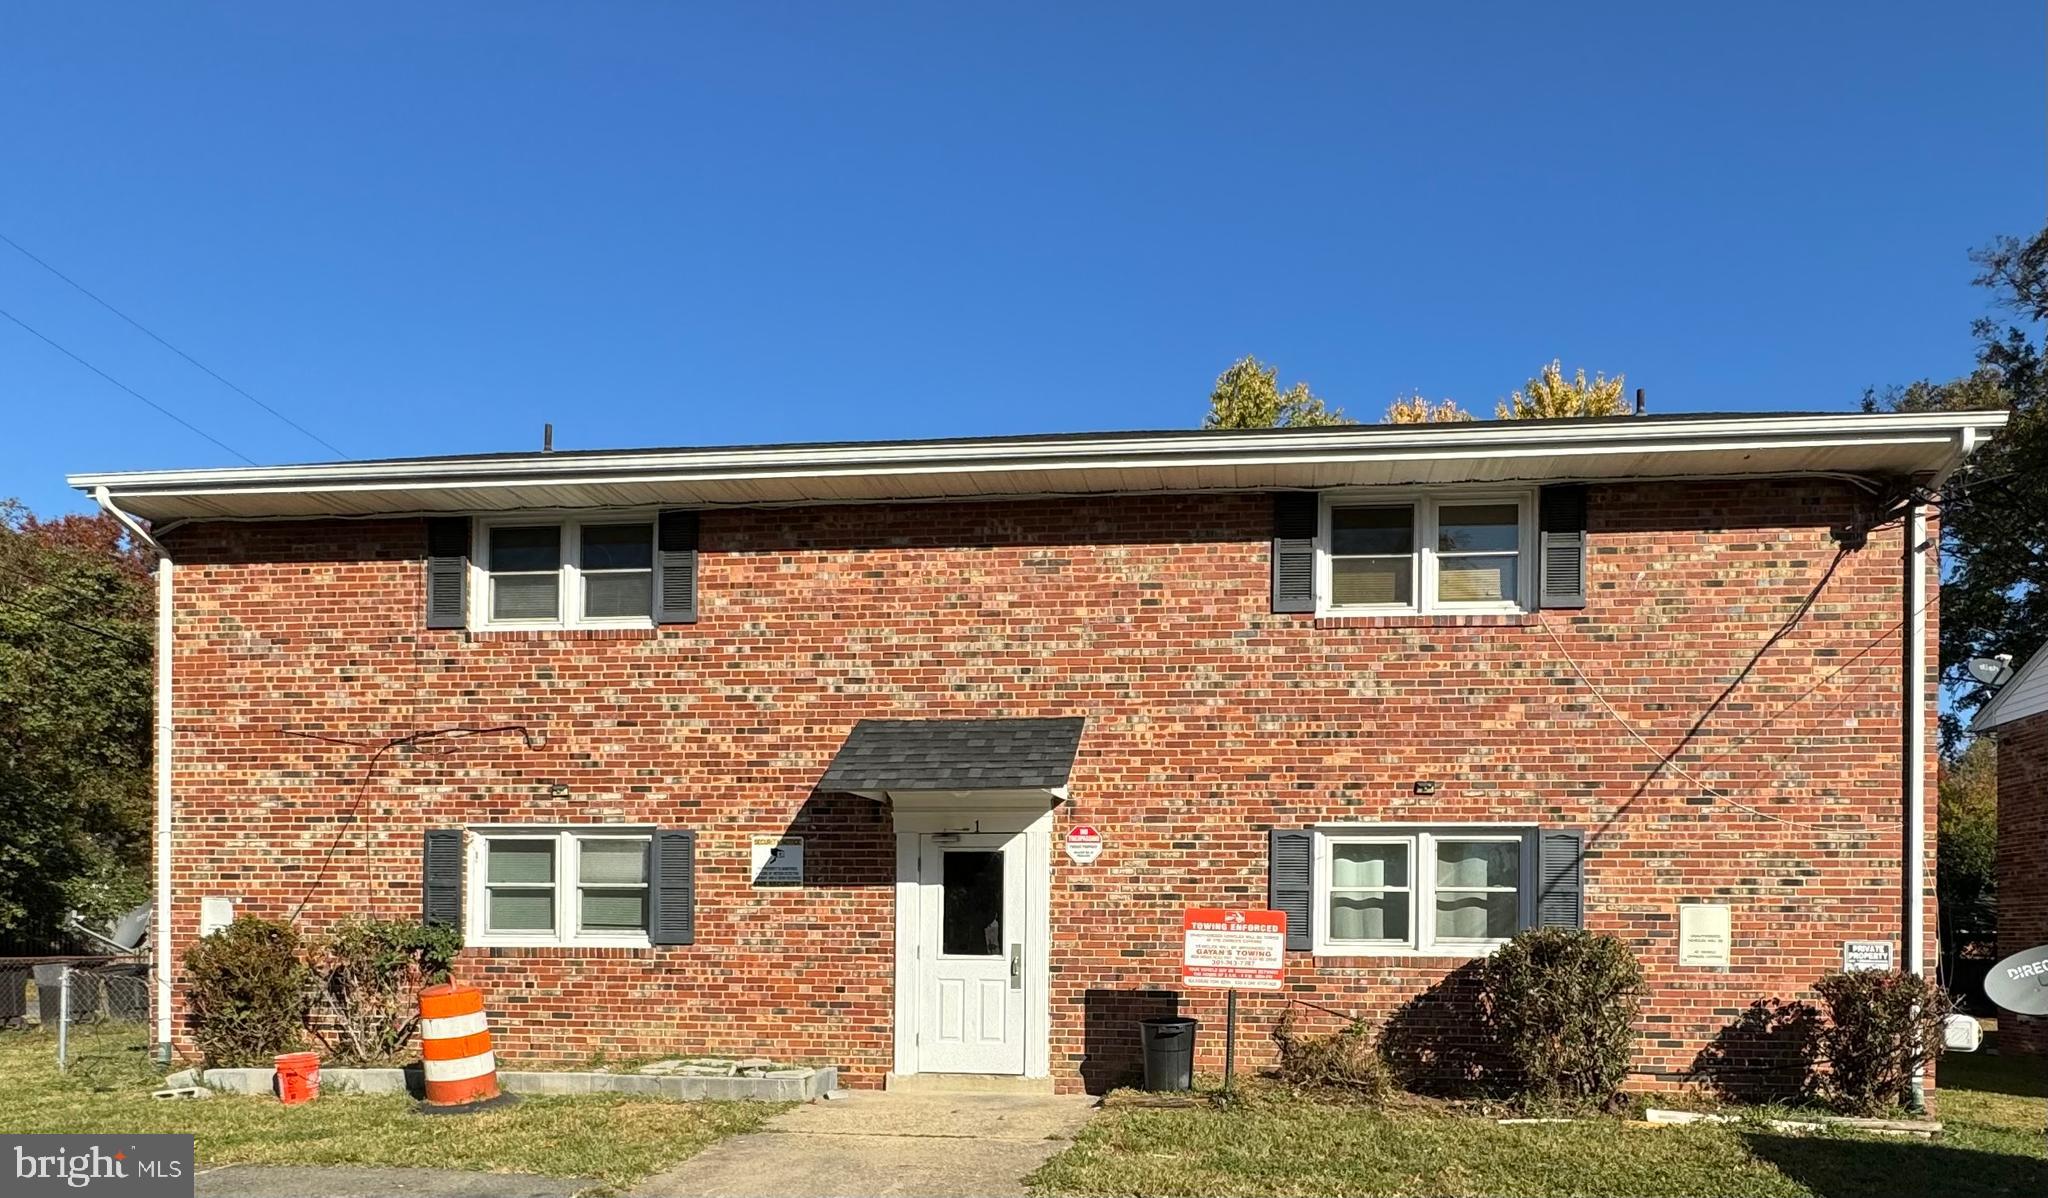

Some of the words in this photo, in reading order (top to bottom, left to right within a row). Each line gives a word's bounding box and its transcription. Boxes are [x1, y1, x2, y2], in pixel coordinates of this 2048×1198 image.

[1979, 664, 1999, 672] dish
[1192, 922, 1227, 931] TOWING
[1231, 923, 1279, 932] ENFORCED
[1848, 952, 1888, 960] PROPERTY
